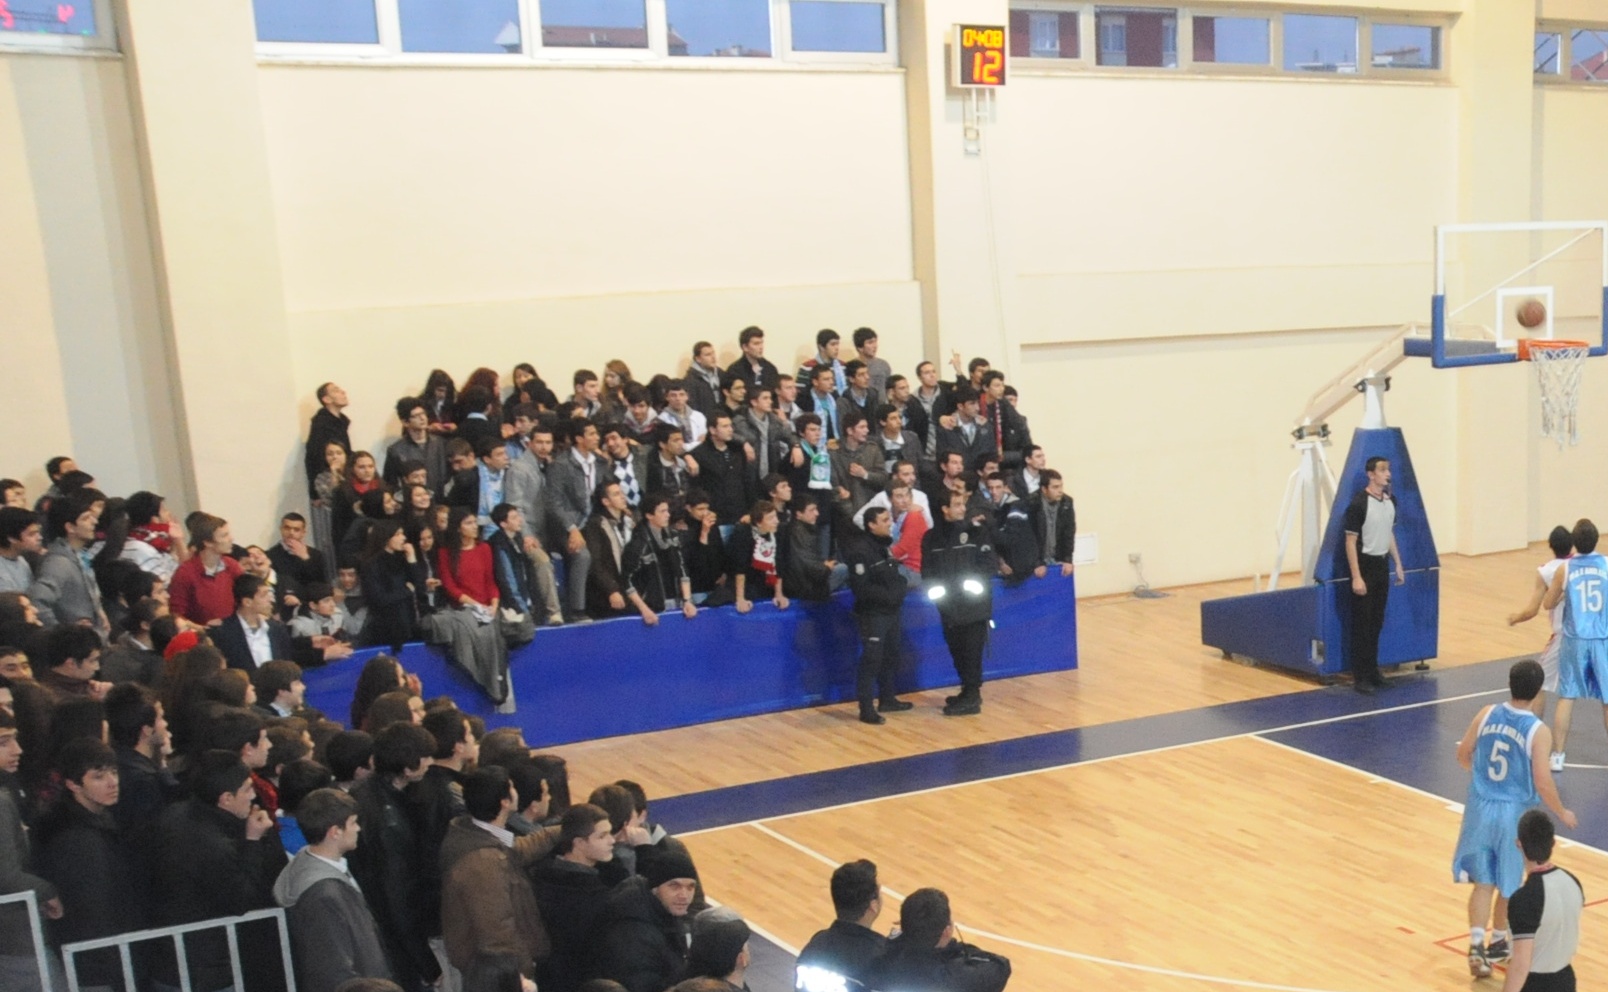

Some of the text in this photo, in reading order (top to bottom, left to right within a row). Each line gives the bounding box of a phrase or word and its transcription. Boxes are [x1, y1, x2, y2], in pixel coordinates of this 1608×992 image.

[973, 50, 1002, 84] 12
[1576, 579, 1603, 613] 15
[1488, 739, 1510, 781] 5
